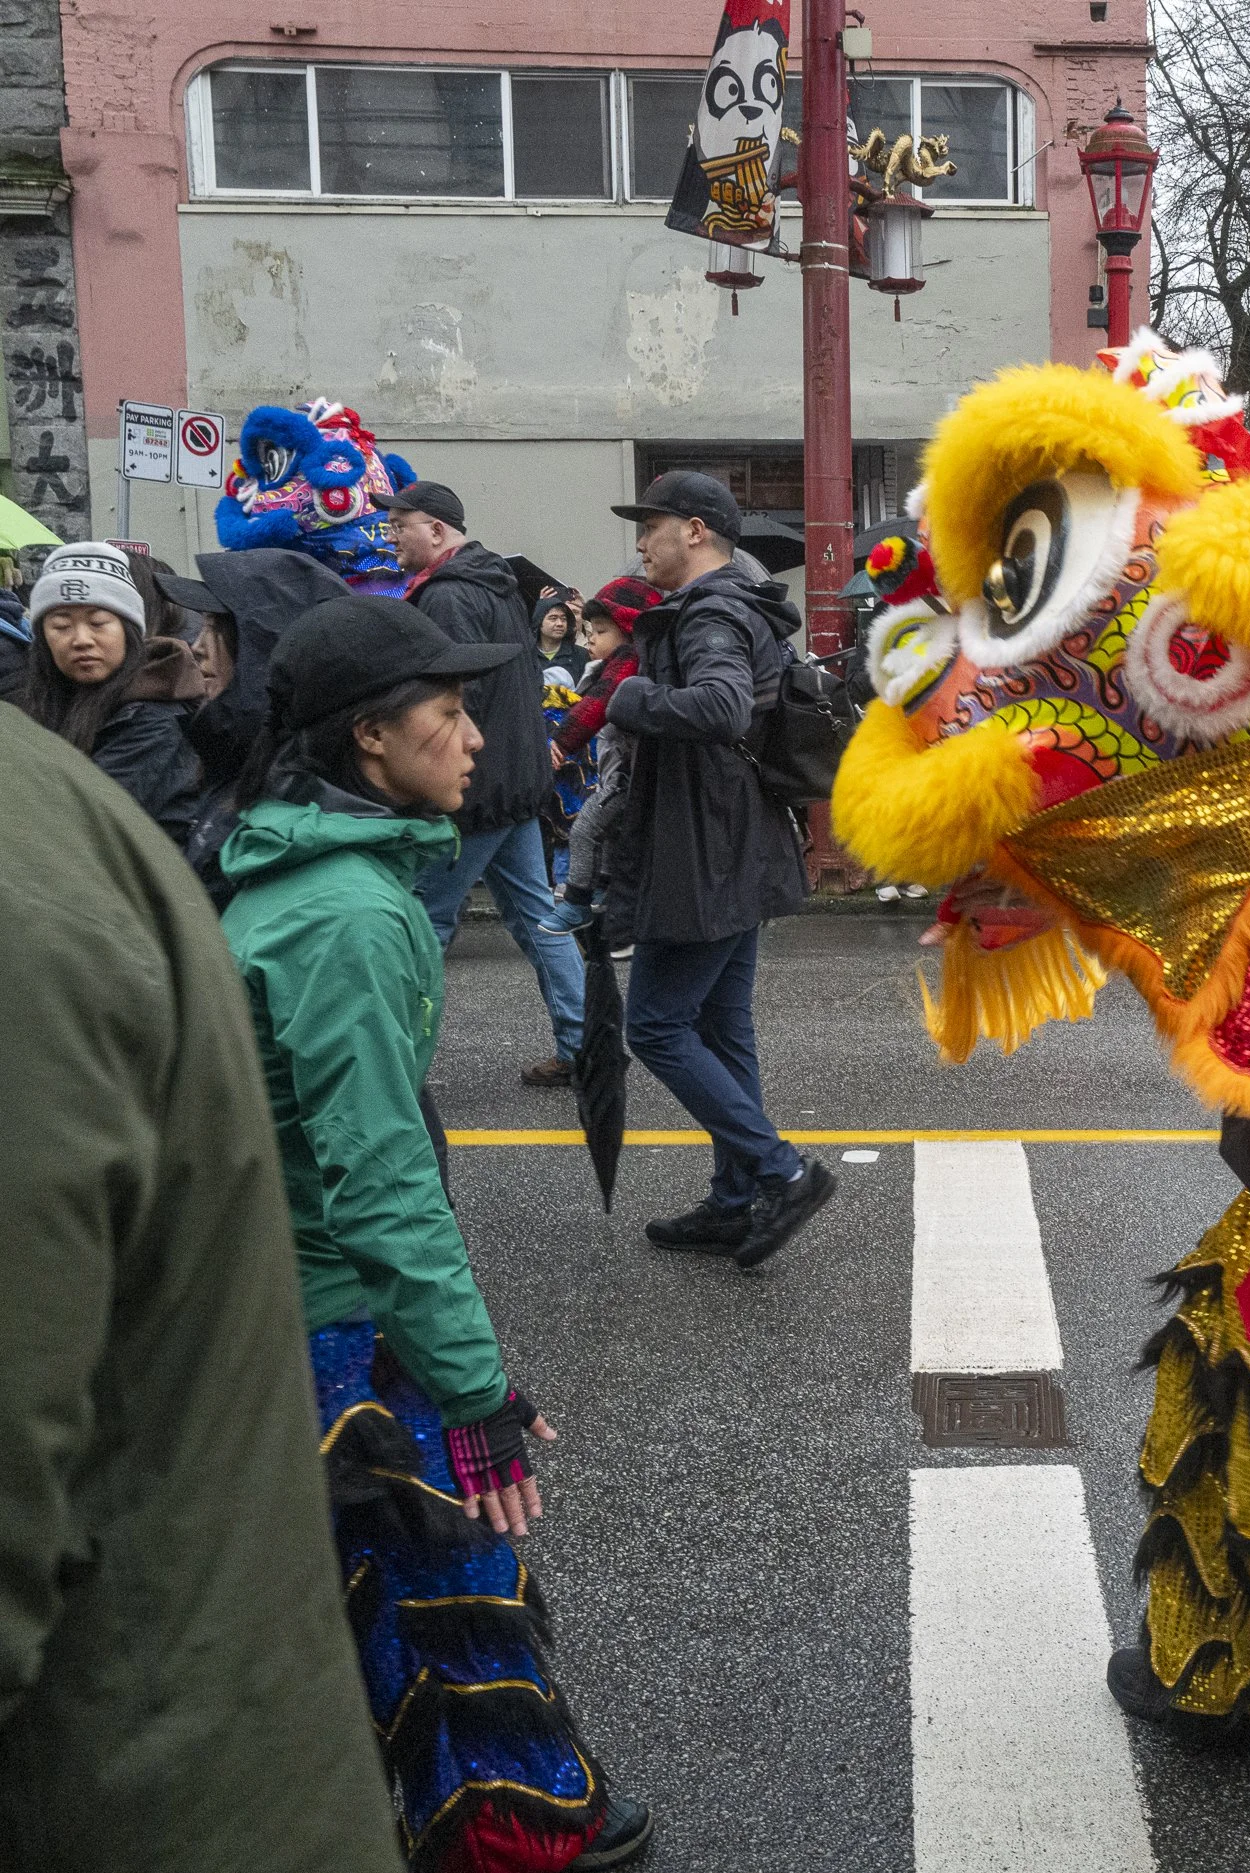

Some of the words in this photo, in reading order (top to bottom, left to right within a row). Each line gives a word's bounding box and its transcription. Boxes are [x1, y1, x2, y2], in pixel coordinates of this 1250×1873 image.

[126, 413, 139, 422] PAY
[140, 414, 172, 427] PARKING
[128, 449, 144, 457] 9AM
[149, 452, 168, 460] 10PM
[827, 543, 832, 552] 4
[823, 552, 835, 562] 51
